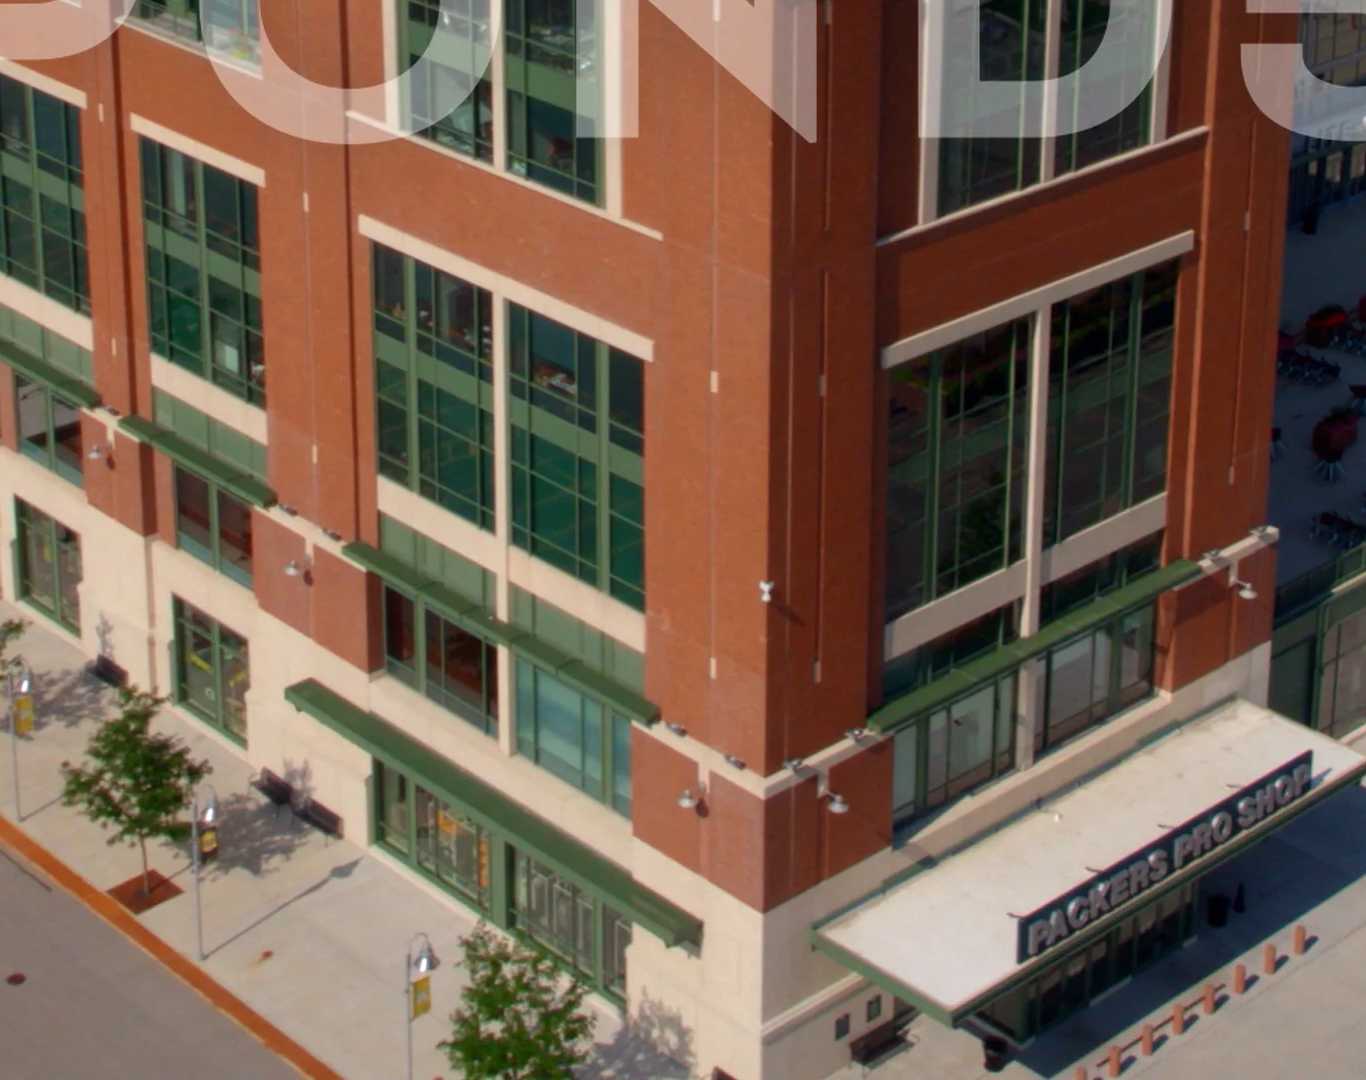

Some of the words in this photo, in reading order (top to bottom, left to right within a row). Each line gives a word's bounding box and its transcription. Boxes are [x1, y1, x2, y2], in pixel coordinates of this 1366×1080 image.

[1028, 848, 1168, 954] PACKERS
[1174, 812, 1232, 870] PRO
[1238, 764, 1312, 828] SHOP
